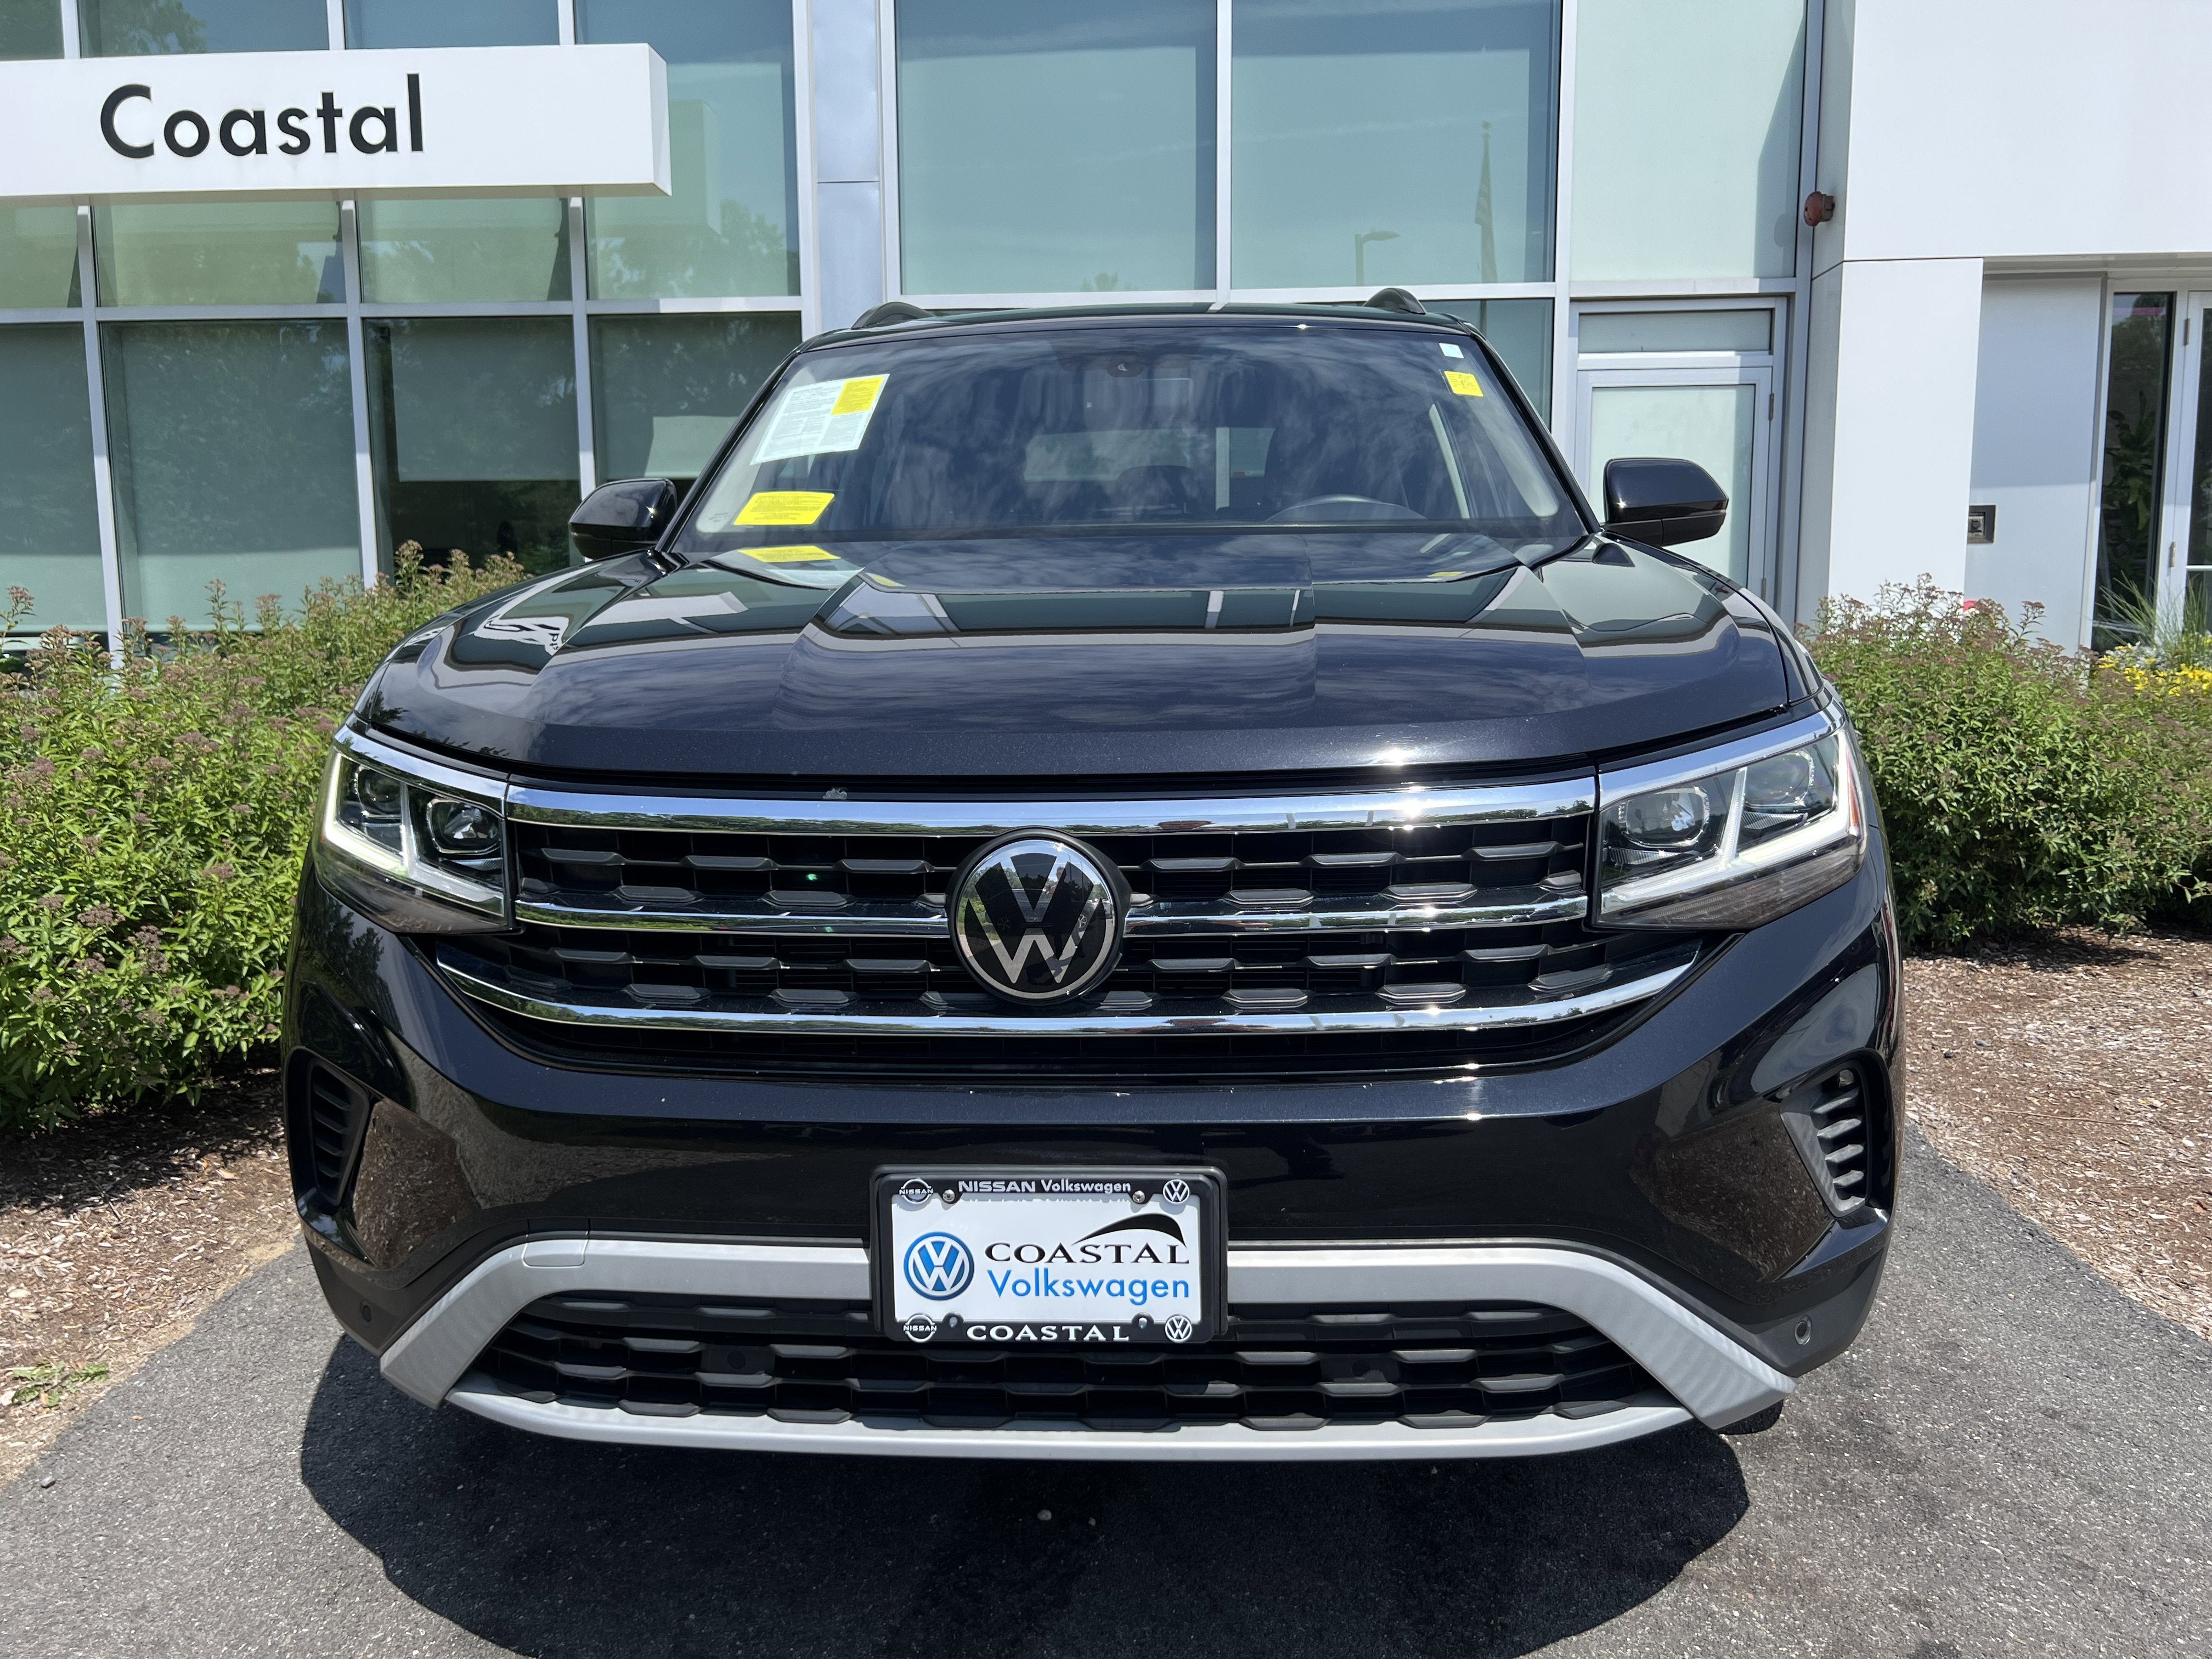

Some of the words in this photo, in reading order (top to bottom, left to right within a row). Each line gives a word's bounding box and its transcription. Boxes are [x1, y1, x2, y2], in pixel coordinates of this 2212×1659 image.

[100, 72, 425, 159] Coastal
[958, 1181, 1036, 1192] NISSAN
[1041, 1179, 1131, 1193] Volkswagen
[985, 1242, 1189, 1264] COASTAL
[987, 1267, 1189, 1306] Volkswagen
[967, 1325, 1130, 1342] COASTAL
